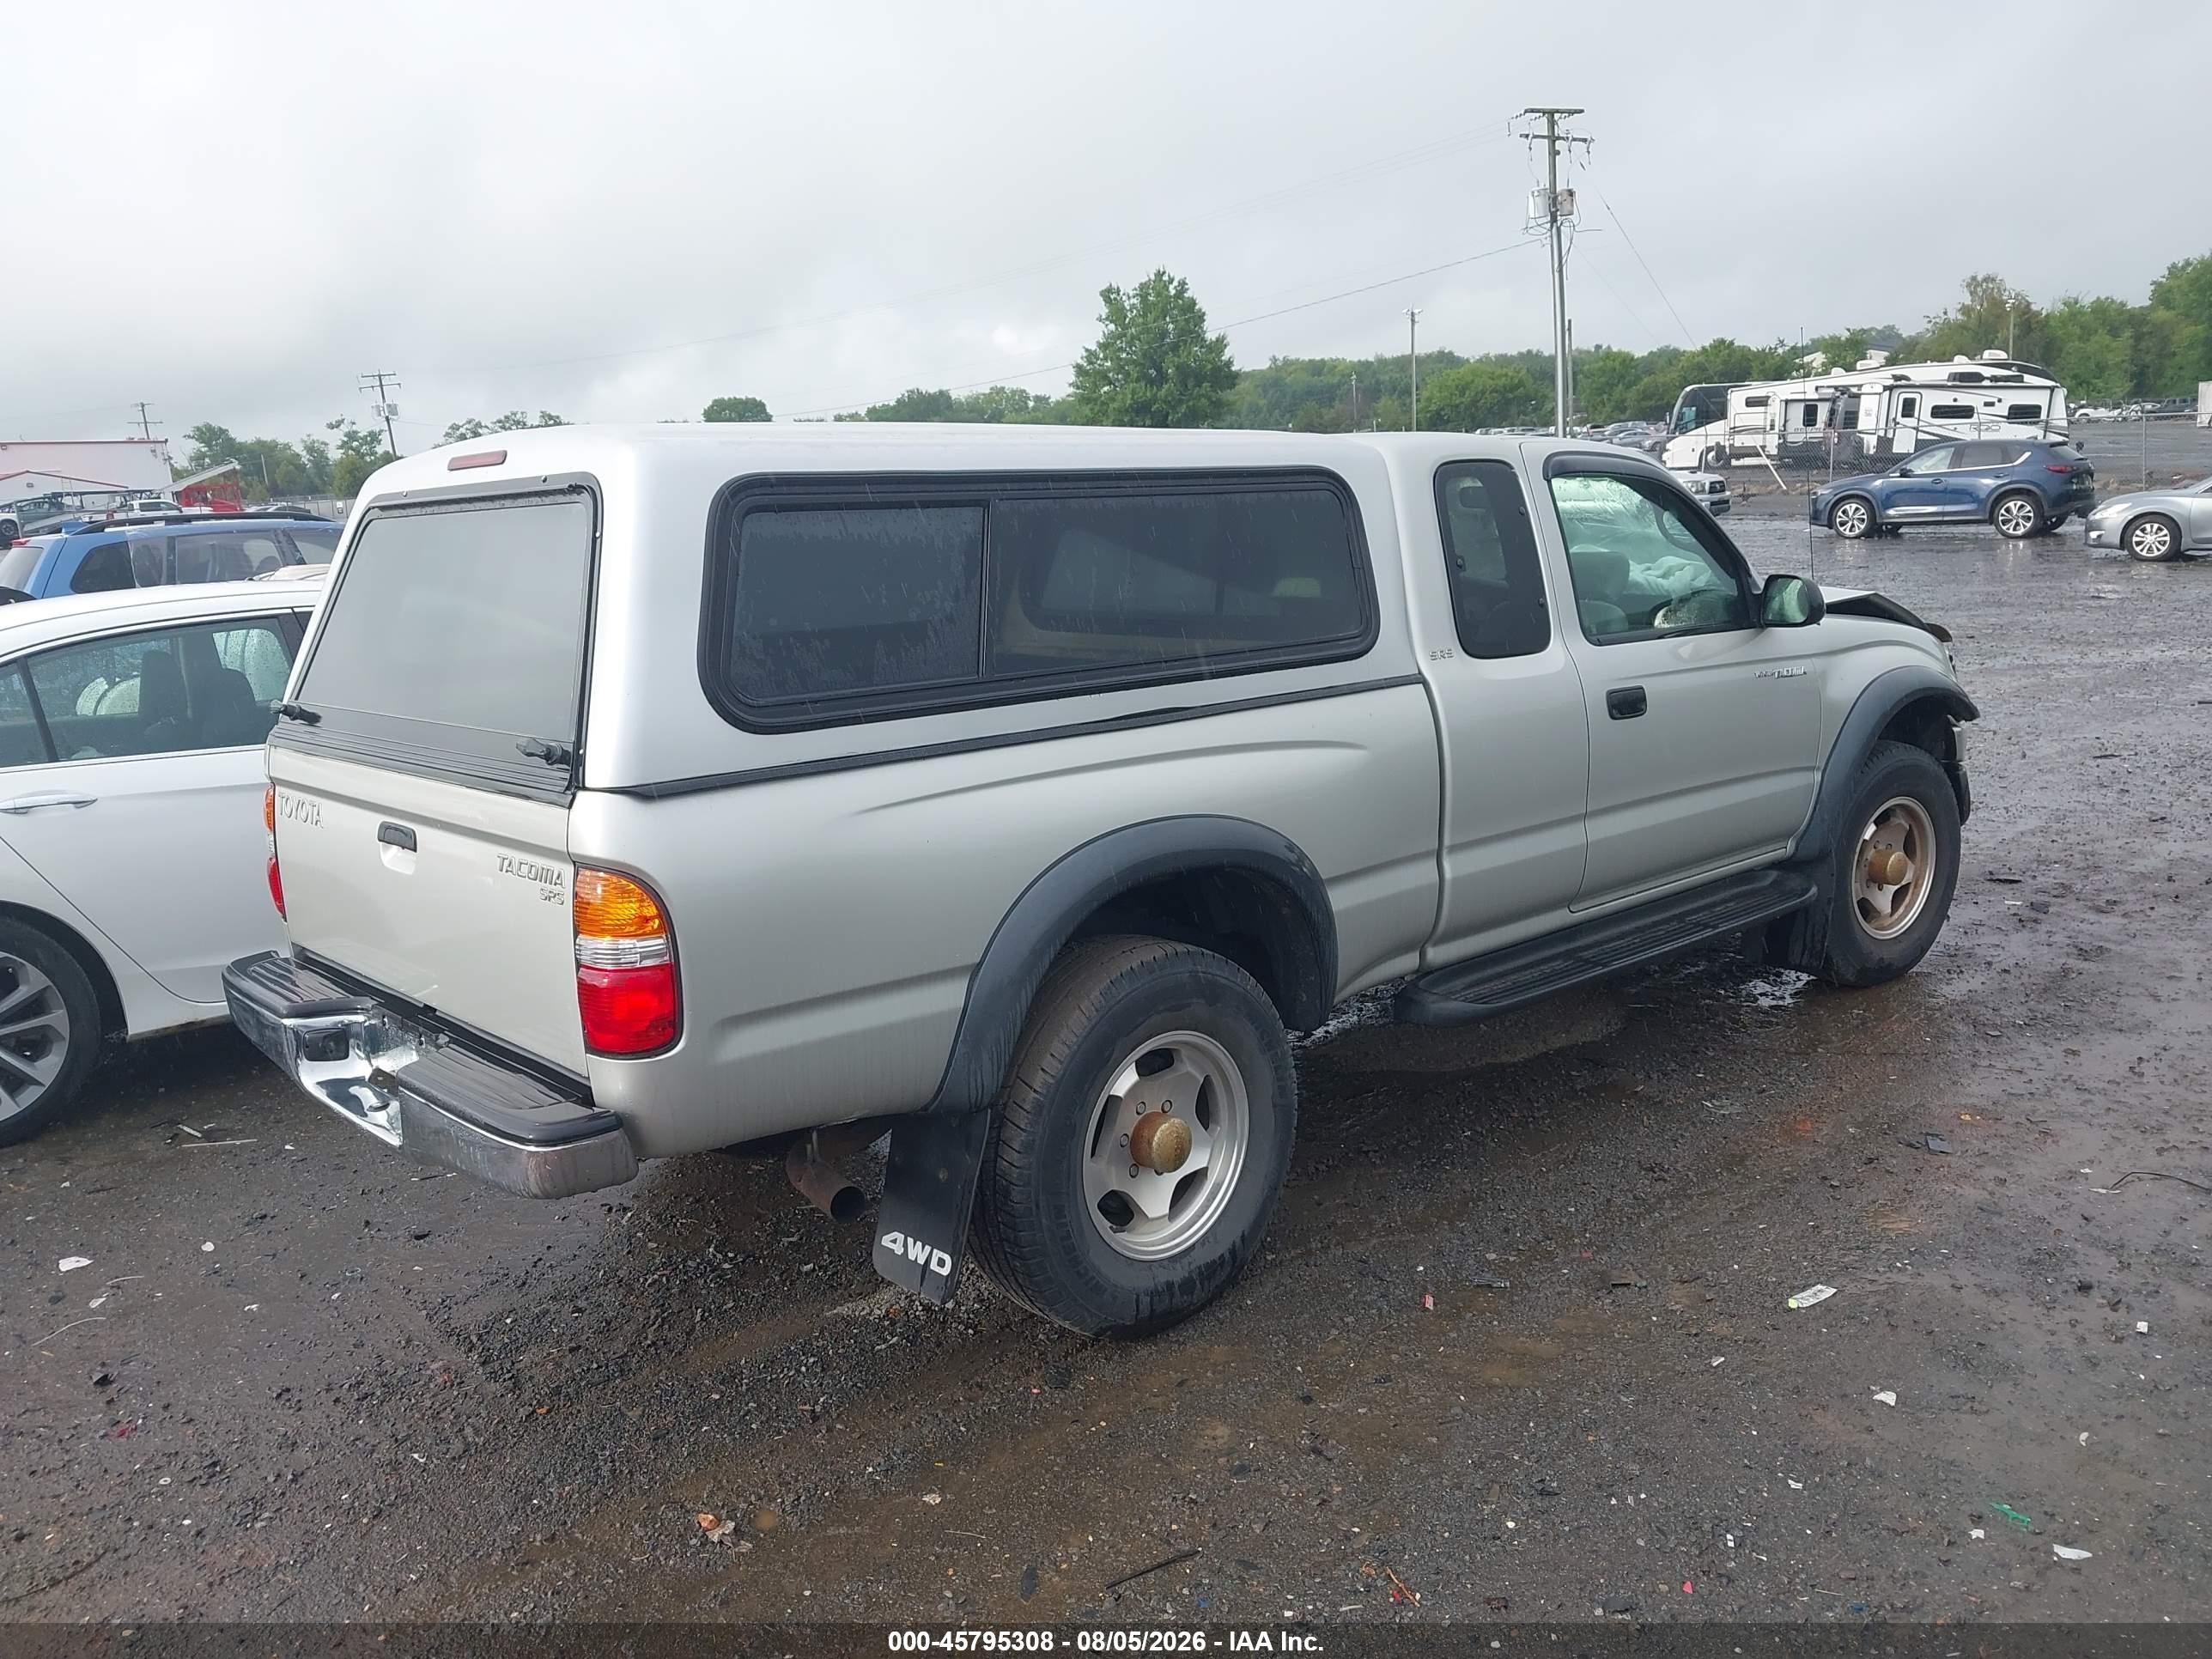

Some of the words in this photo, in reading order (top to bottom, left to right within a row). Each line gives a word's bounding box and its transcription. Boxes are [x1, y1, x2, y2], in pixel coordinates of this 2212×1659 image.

[278, 793, 324, 830] TOYOTA
[497, 853, 566, 890] TACOMA
[881, 1231, 952, 1276] 4WD
